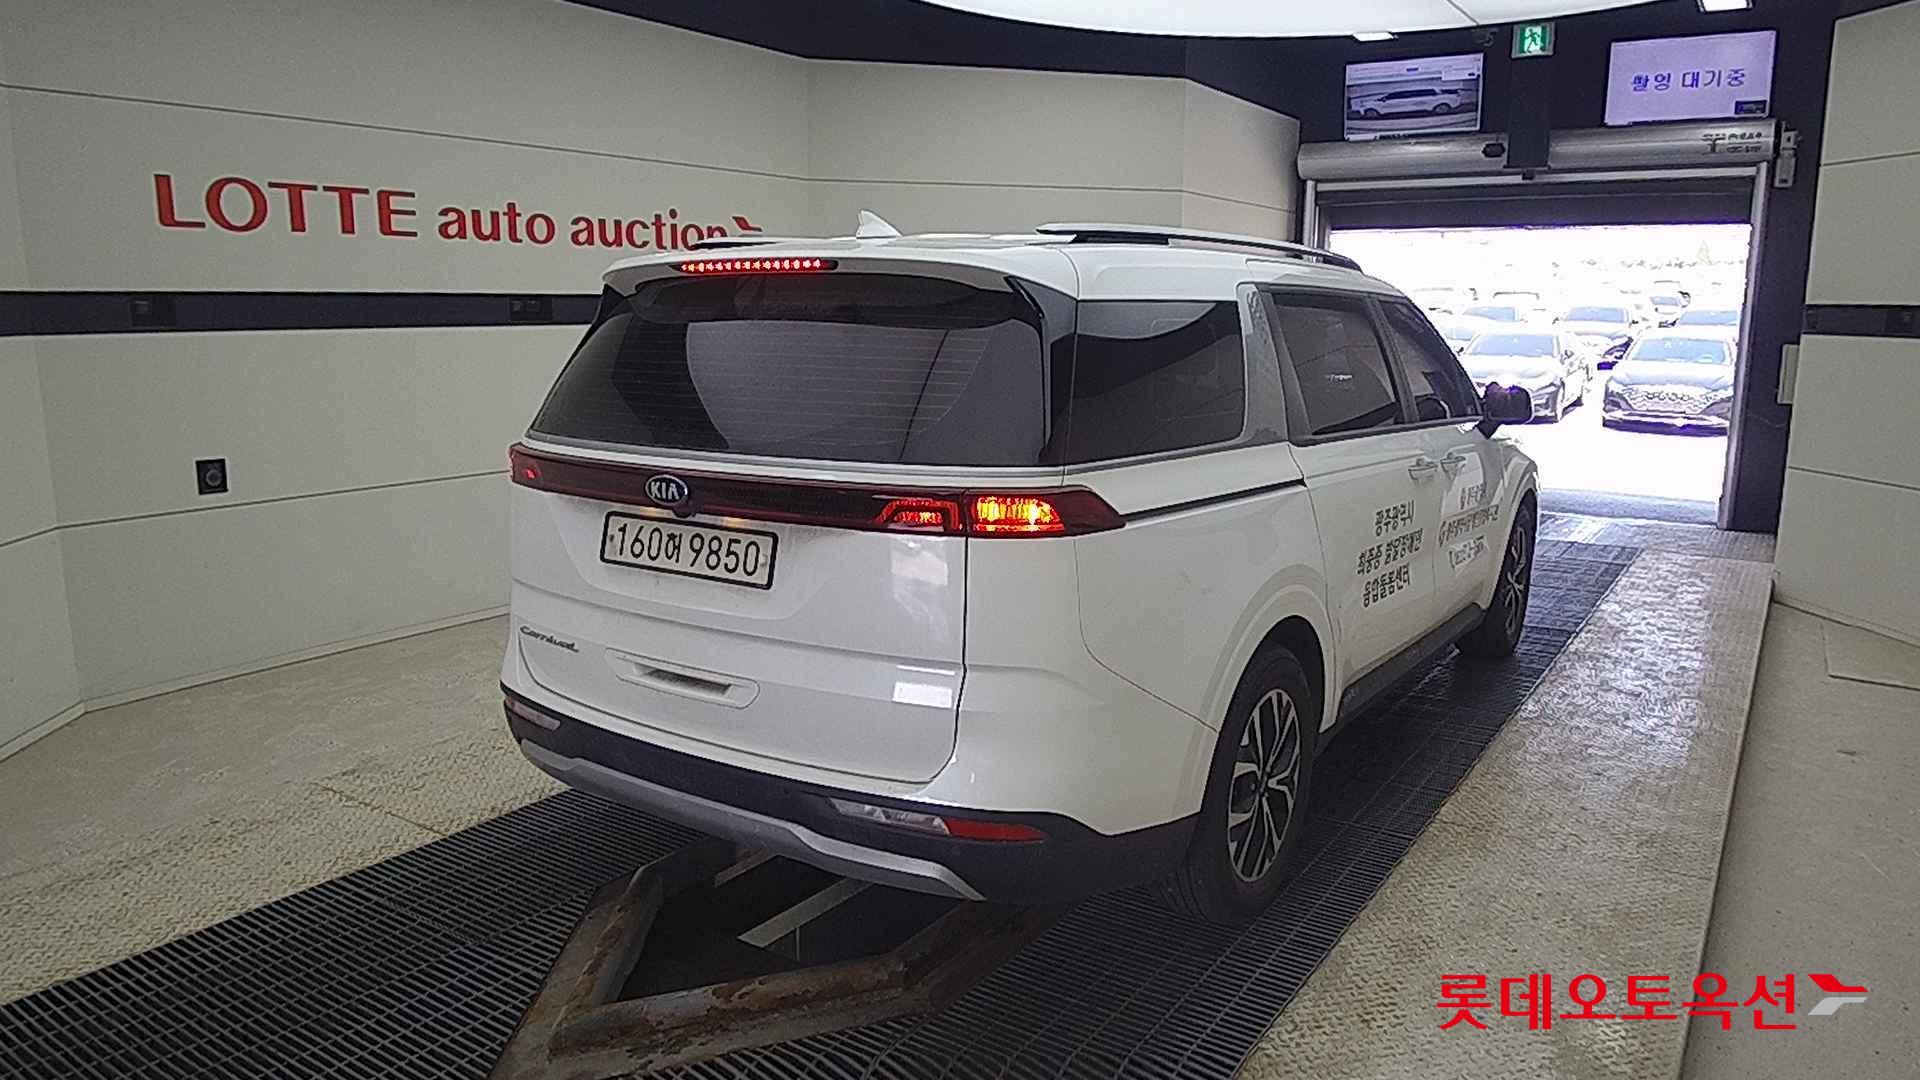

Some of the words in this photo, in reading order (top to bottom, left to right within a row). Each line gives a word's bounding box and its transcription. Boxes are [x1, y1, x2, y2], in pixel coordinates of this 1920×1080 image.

[1681, 69, 1746, 88] 대기중
[154, 174, 418, 237] LOTTE
[438, 202, 556, 245] auto
[651, 481, 680, 500] KIA
[1375, 500, 1414, 536] 광주광역시
[617, 523, 683, 563] 160허
[689, 532, 761, 577] 9850
